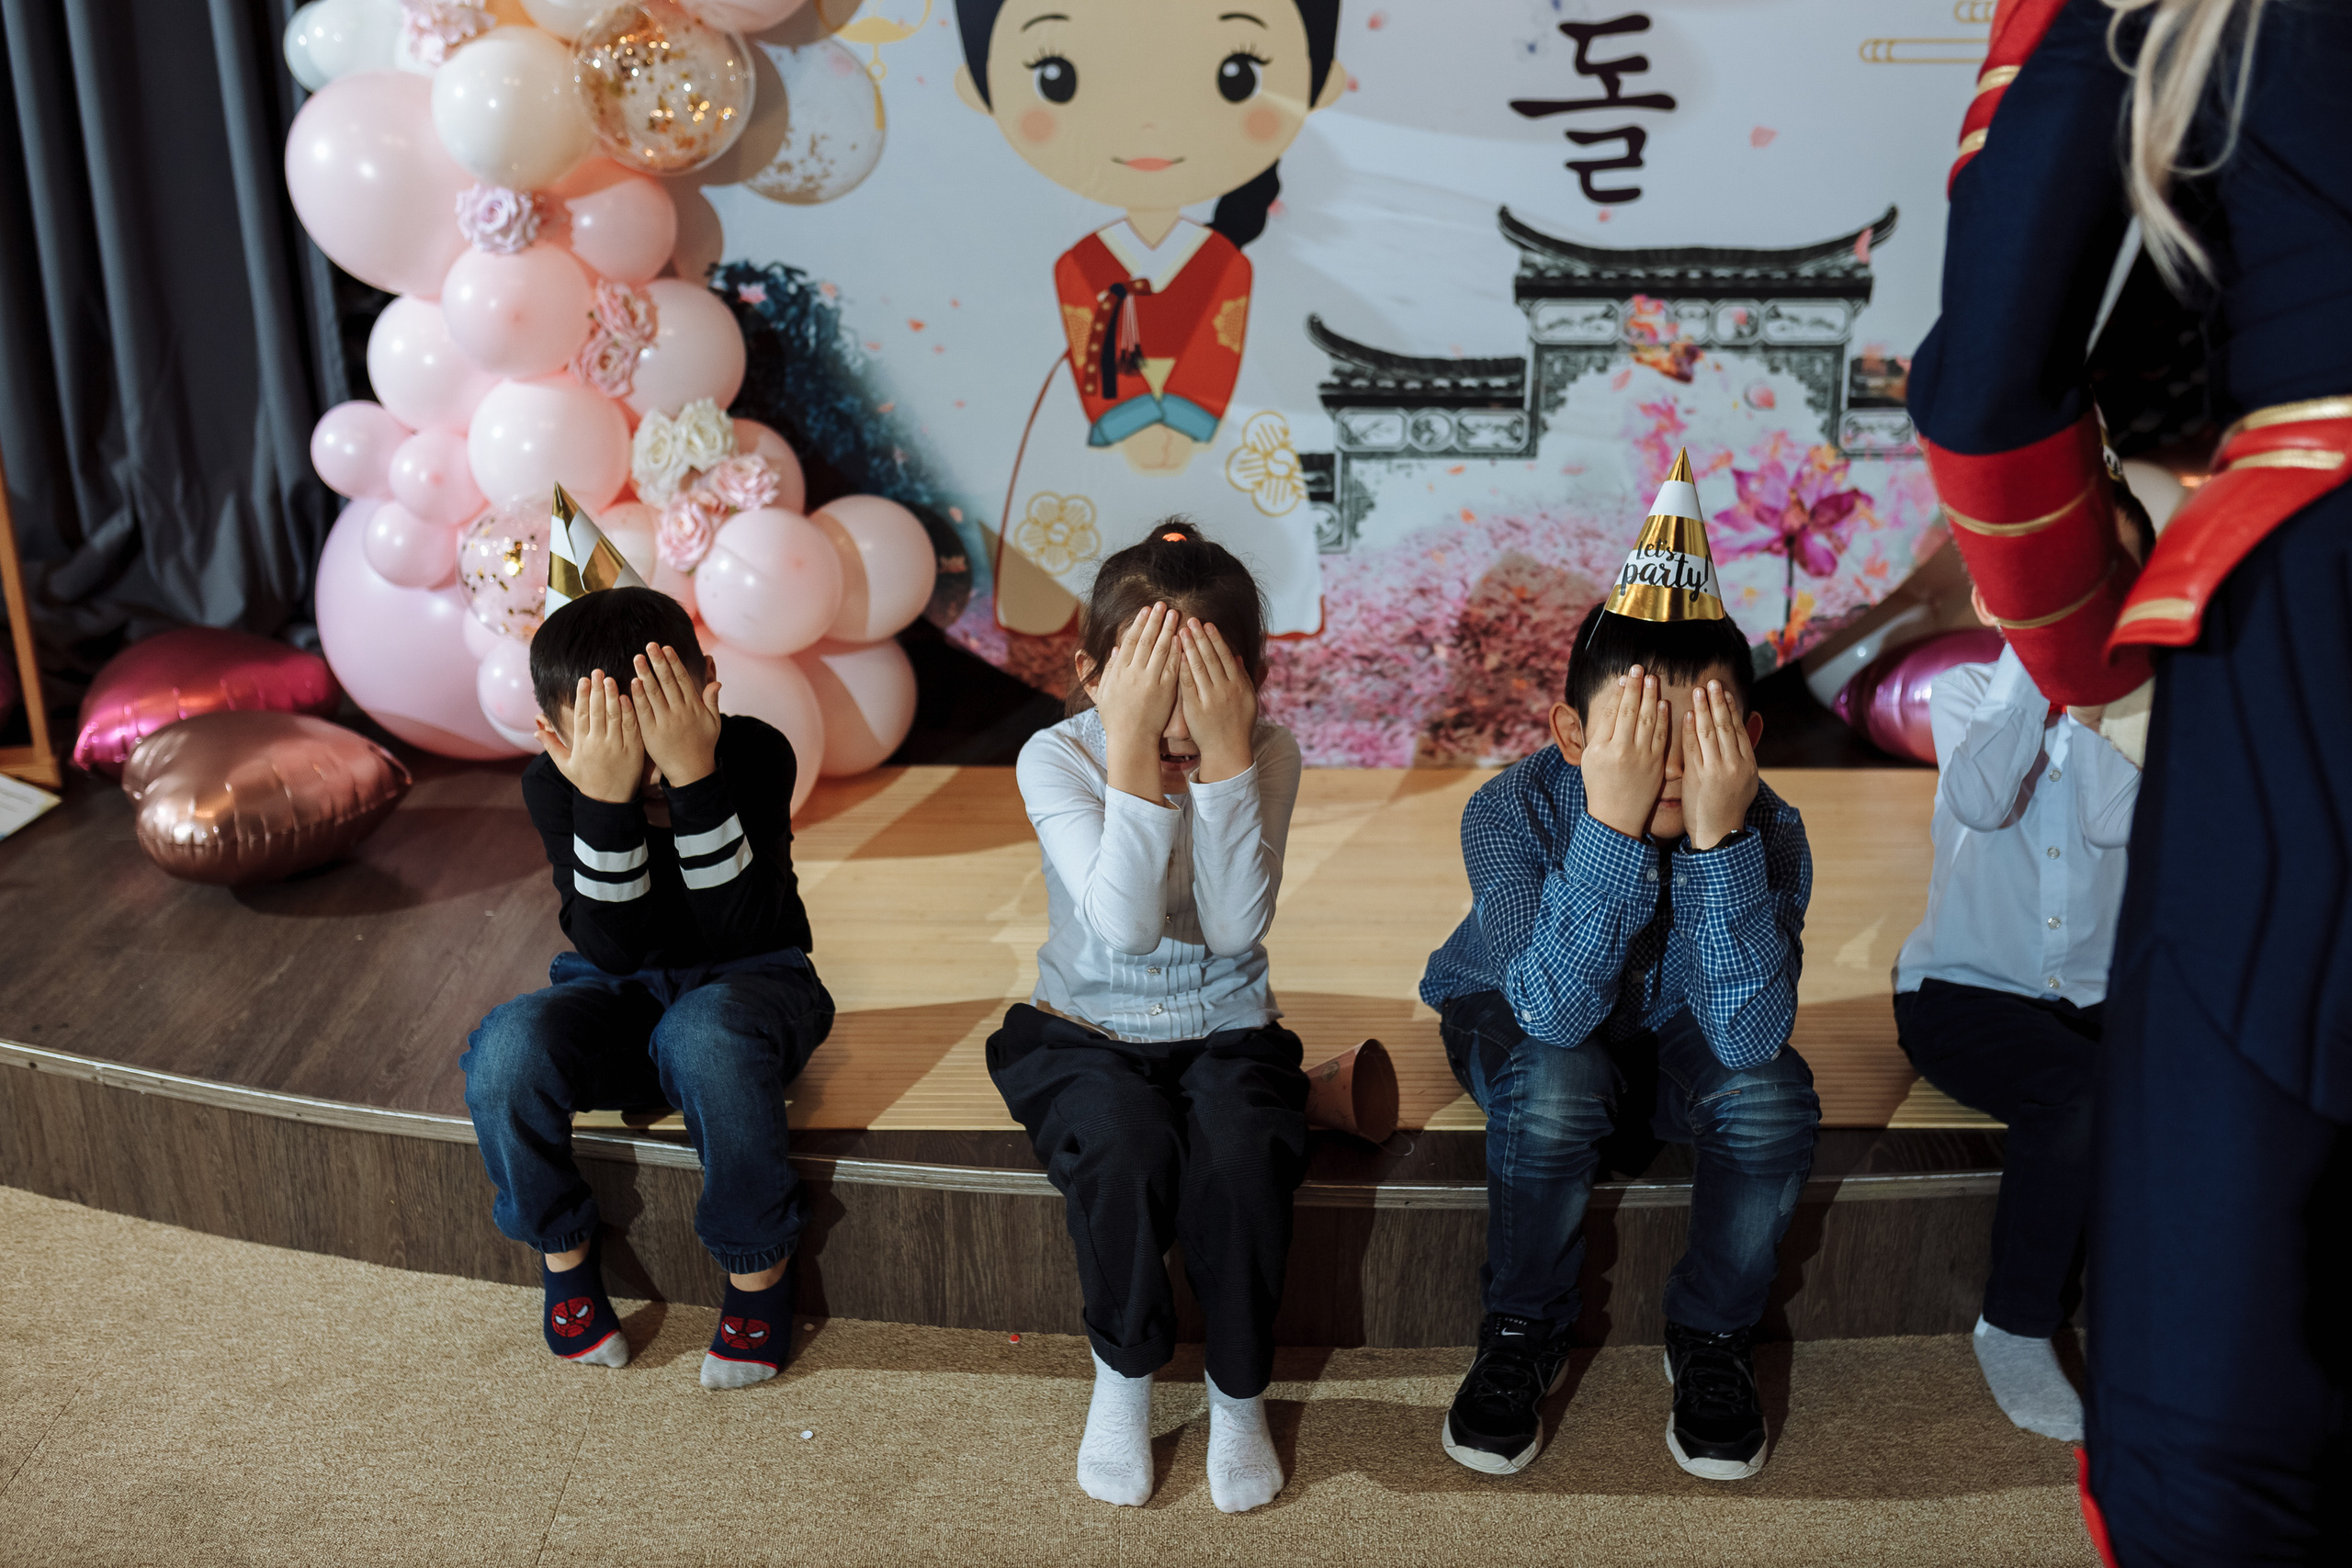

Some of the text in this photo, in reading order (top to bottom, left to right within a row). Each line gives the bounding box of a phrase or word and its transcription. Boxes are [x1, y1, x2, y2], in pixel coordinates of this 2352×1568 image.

[1510, 14, 1676, 204] 돌
[1635, 539, 1677, 561] Let's
[1620, 554, 1709, 603] party!
